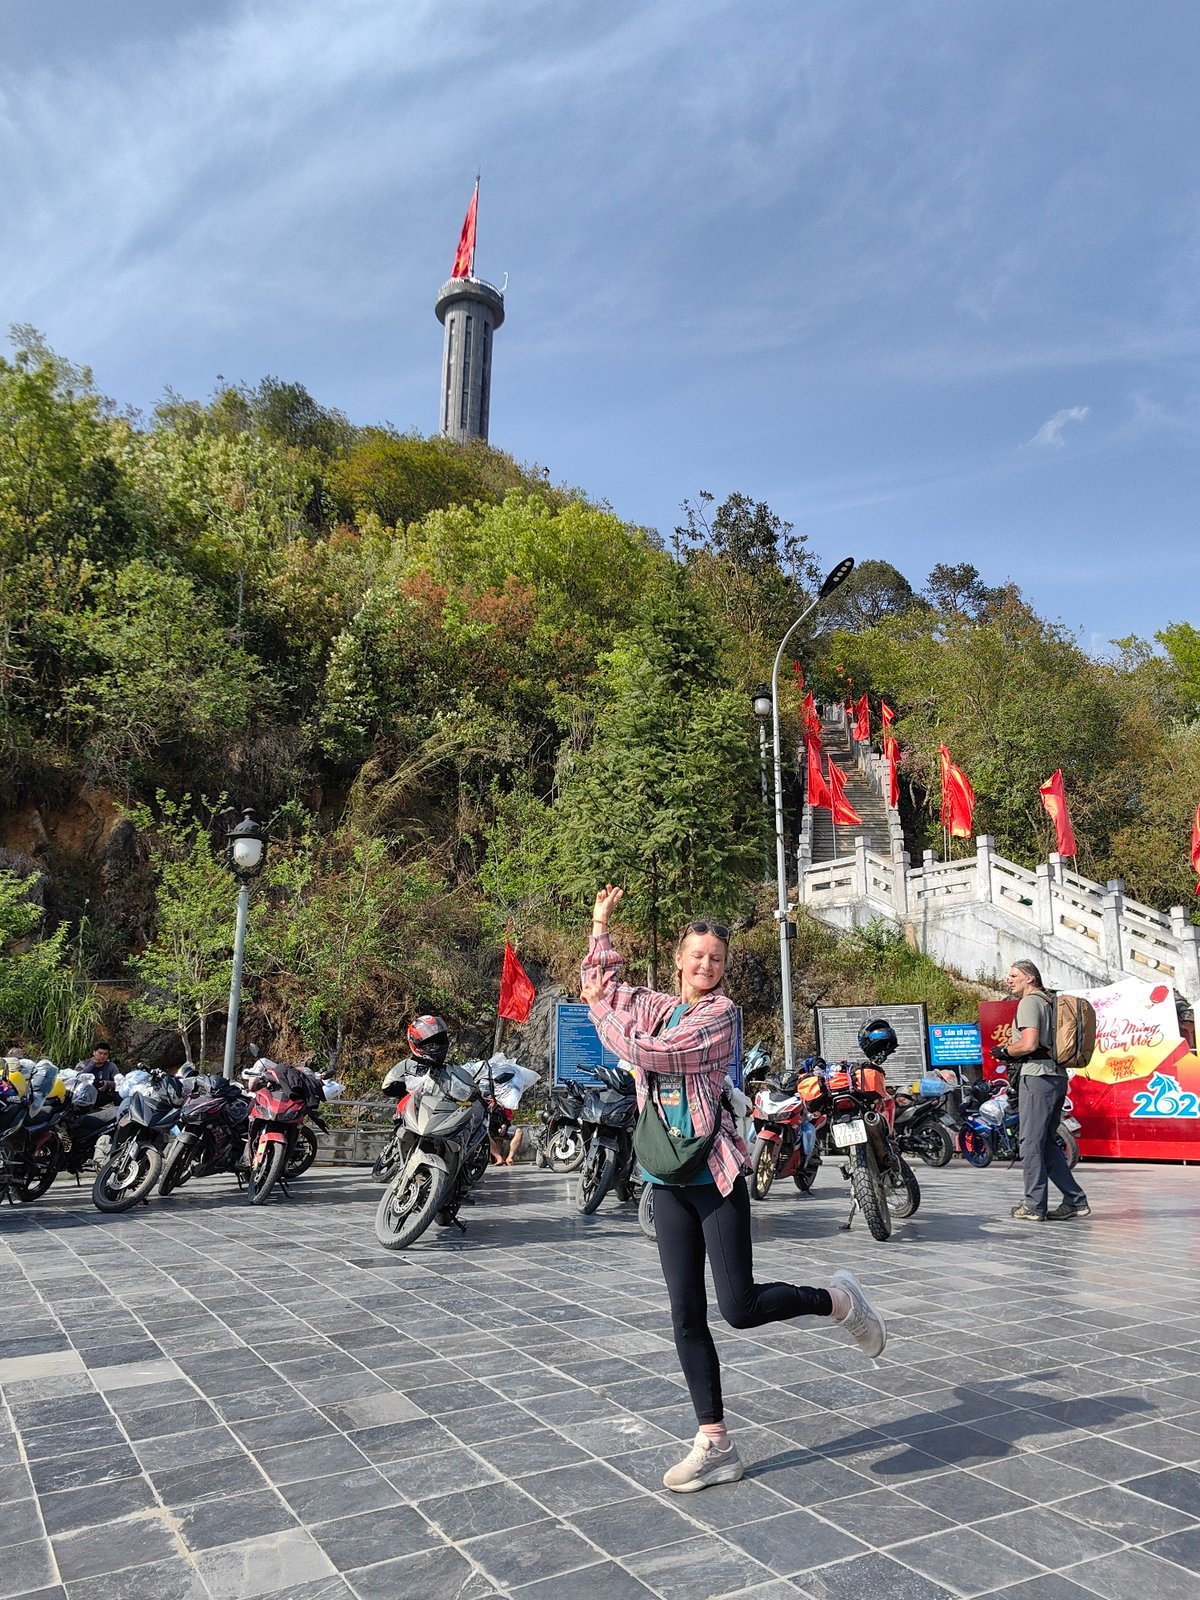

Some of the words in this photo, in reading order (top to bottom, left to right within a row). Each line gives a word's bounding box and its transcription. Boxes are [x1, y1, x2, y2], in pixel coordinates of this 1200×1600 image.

[991, 1024, 1013, 1040] He
[1095, 1018, 1119, 1041] húc
[1107, 1058, 1134, 1069] HAPPY
[1112, 1069, 1139, 1081] YEAR
[1132, 1092, 1200, 1117] 202
